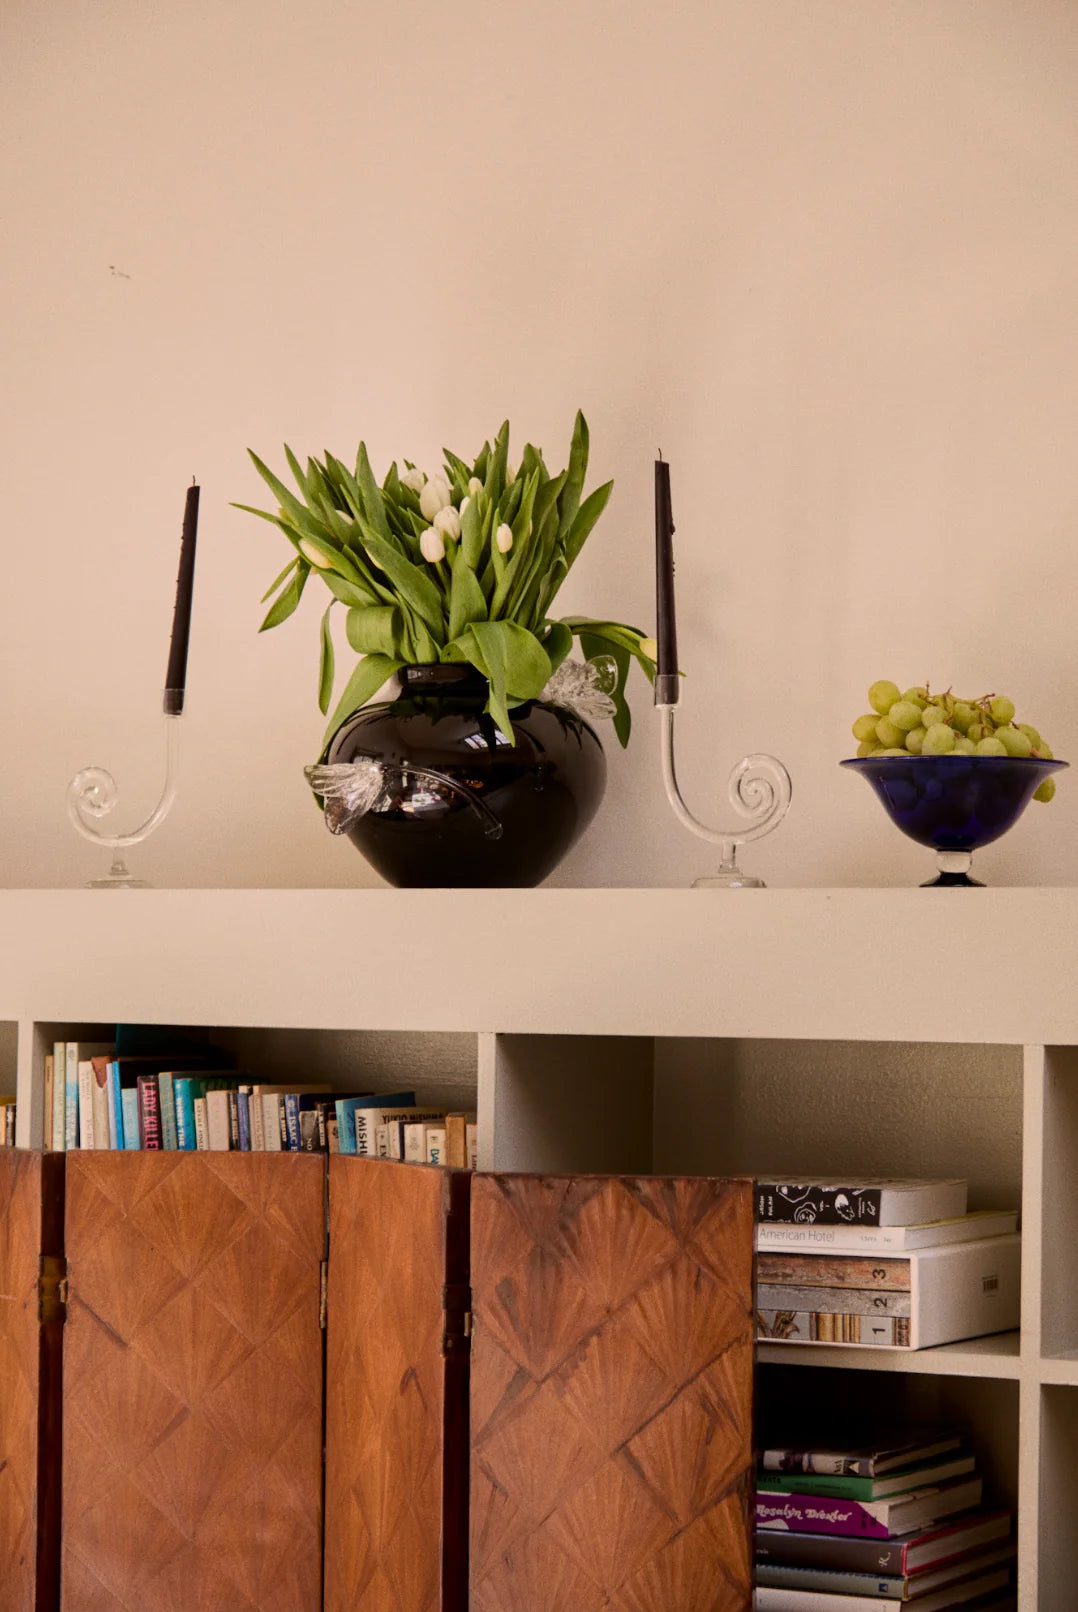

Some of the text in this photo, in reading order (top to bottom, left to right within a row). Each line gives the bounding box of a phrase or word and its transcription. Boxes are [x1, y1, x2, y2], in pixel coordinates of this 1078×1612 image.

[142, 1082, 157, 1112] LADY
[288, 1116, 297, 1144] ISAAC
[759, 1228, 835, 1243] American Hotel
[872, 1268, 887, 1280] 3
[874, 1297, 888, 1308] 2
[872, 1327, 887, 1336] 1
[804, 1508, 853, 1523] Drexler
